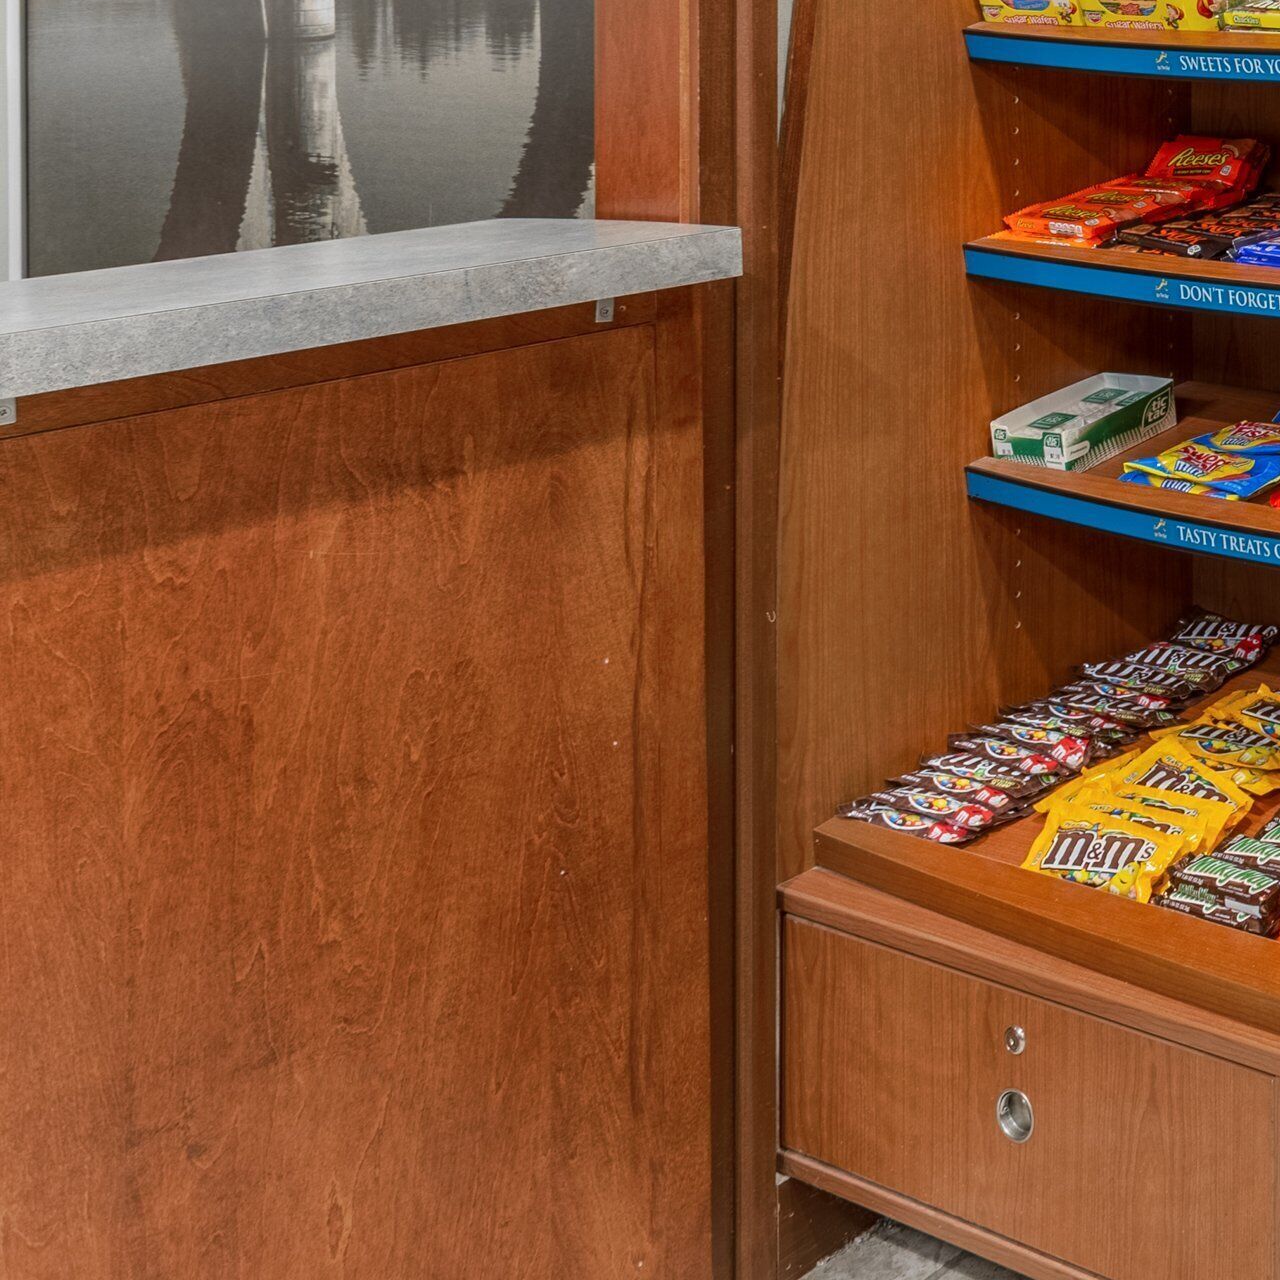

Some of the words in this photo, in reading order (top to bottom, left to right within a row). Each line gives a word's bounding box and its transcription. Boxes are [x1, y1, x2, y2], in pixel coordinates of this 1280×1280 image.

[1179, 54, 1231, 73] SWEETS
[1234, 56, 1263, 73] FOR
[1180, 284, 1224, 303] DON'T
[1152, 395, 1168, 411] tic
[1147, 407, 1167, 425] tac
[1177, 525, 1218, 547] TASTY
[1220, 532, 1270, 557] TREATS
